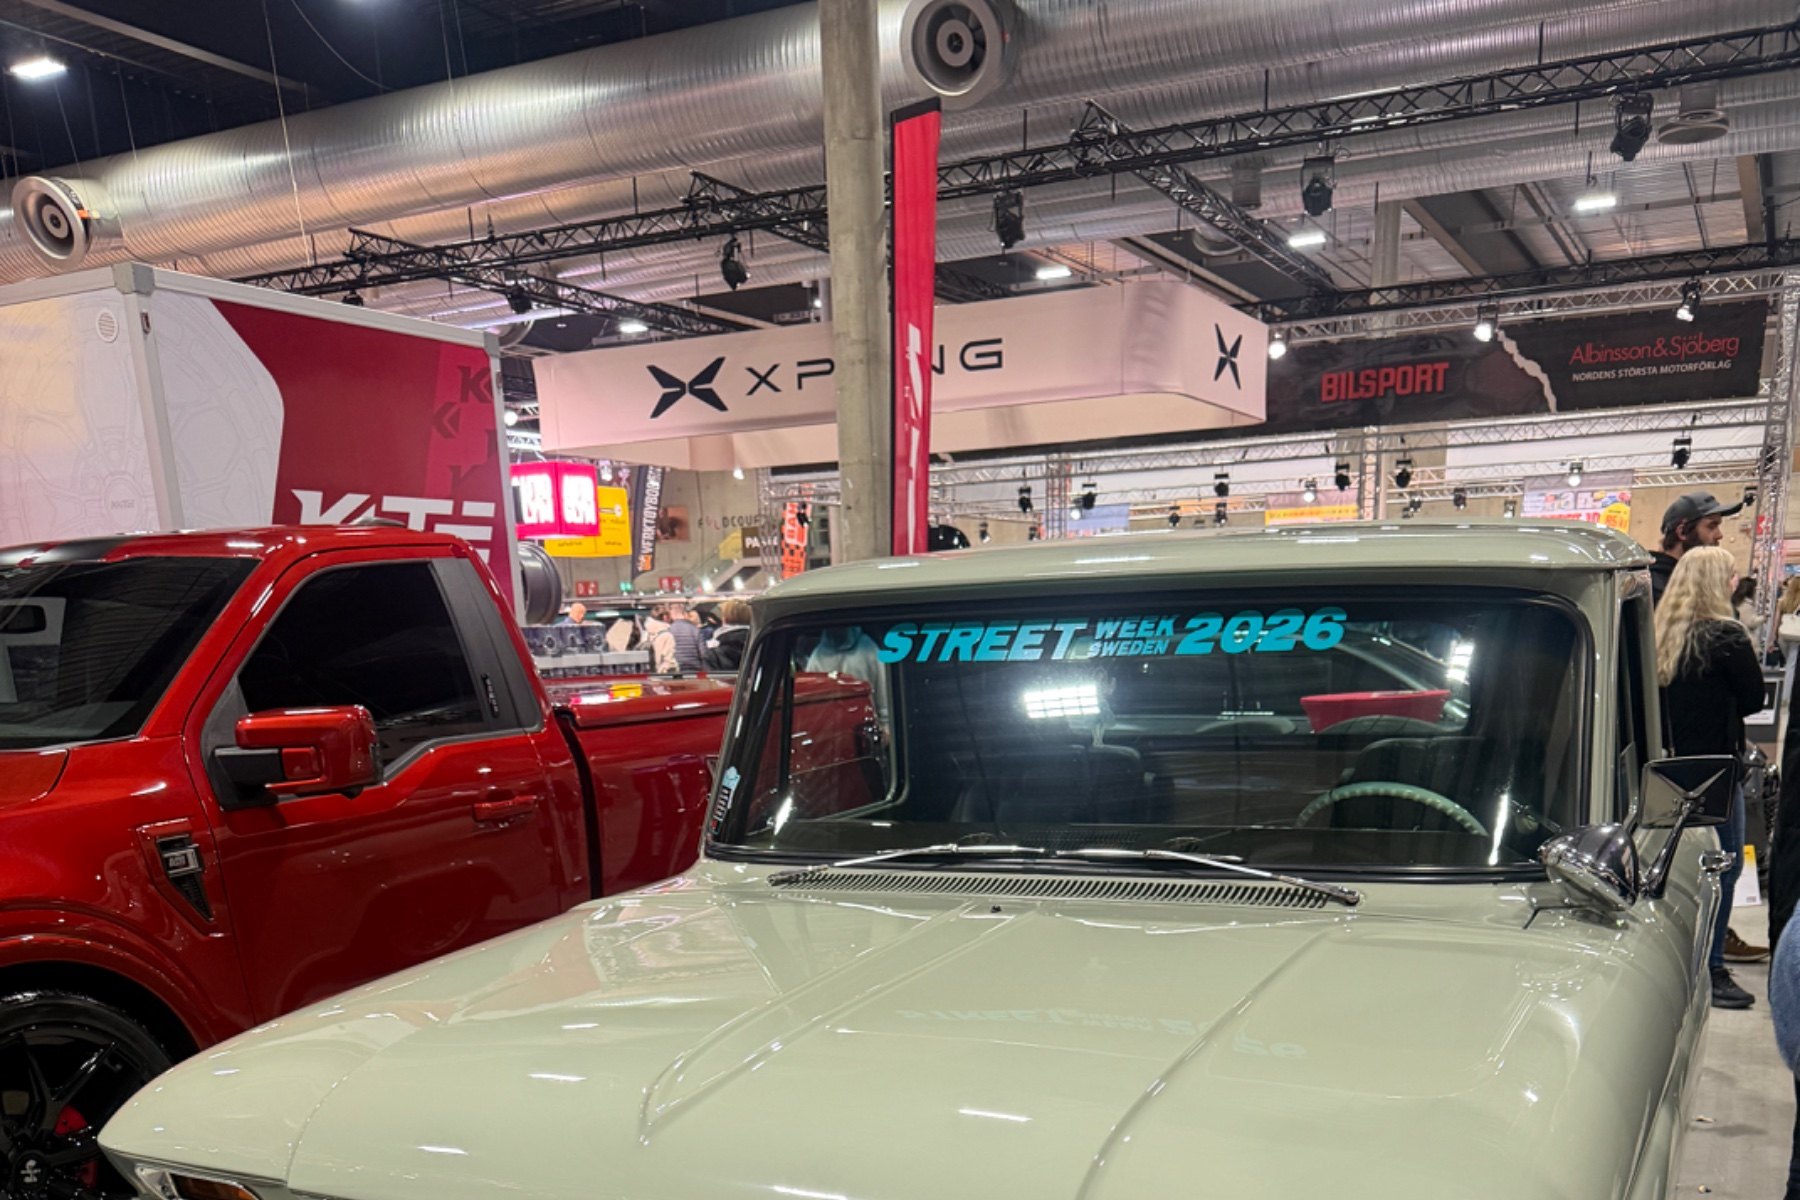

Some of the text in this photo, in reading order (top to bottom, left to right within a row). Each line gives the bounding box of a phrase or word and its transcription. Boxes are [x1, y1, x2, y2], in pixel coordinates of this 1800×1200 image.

[1320, 361, 1450, 403] BILSPORT
[1572, 371, 1616, 383] NORDENS
[877, 606, 1348, 664] STREET WEEK 2026
[1087, 639, 1170, 660] SWEDEN
